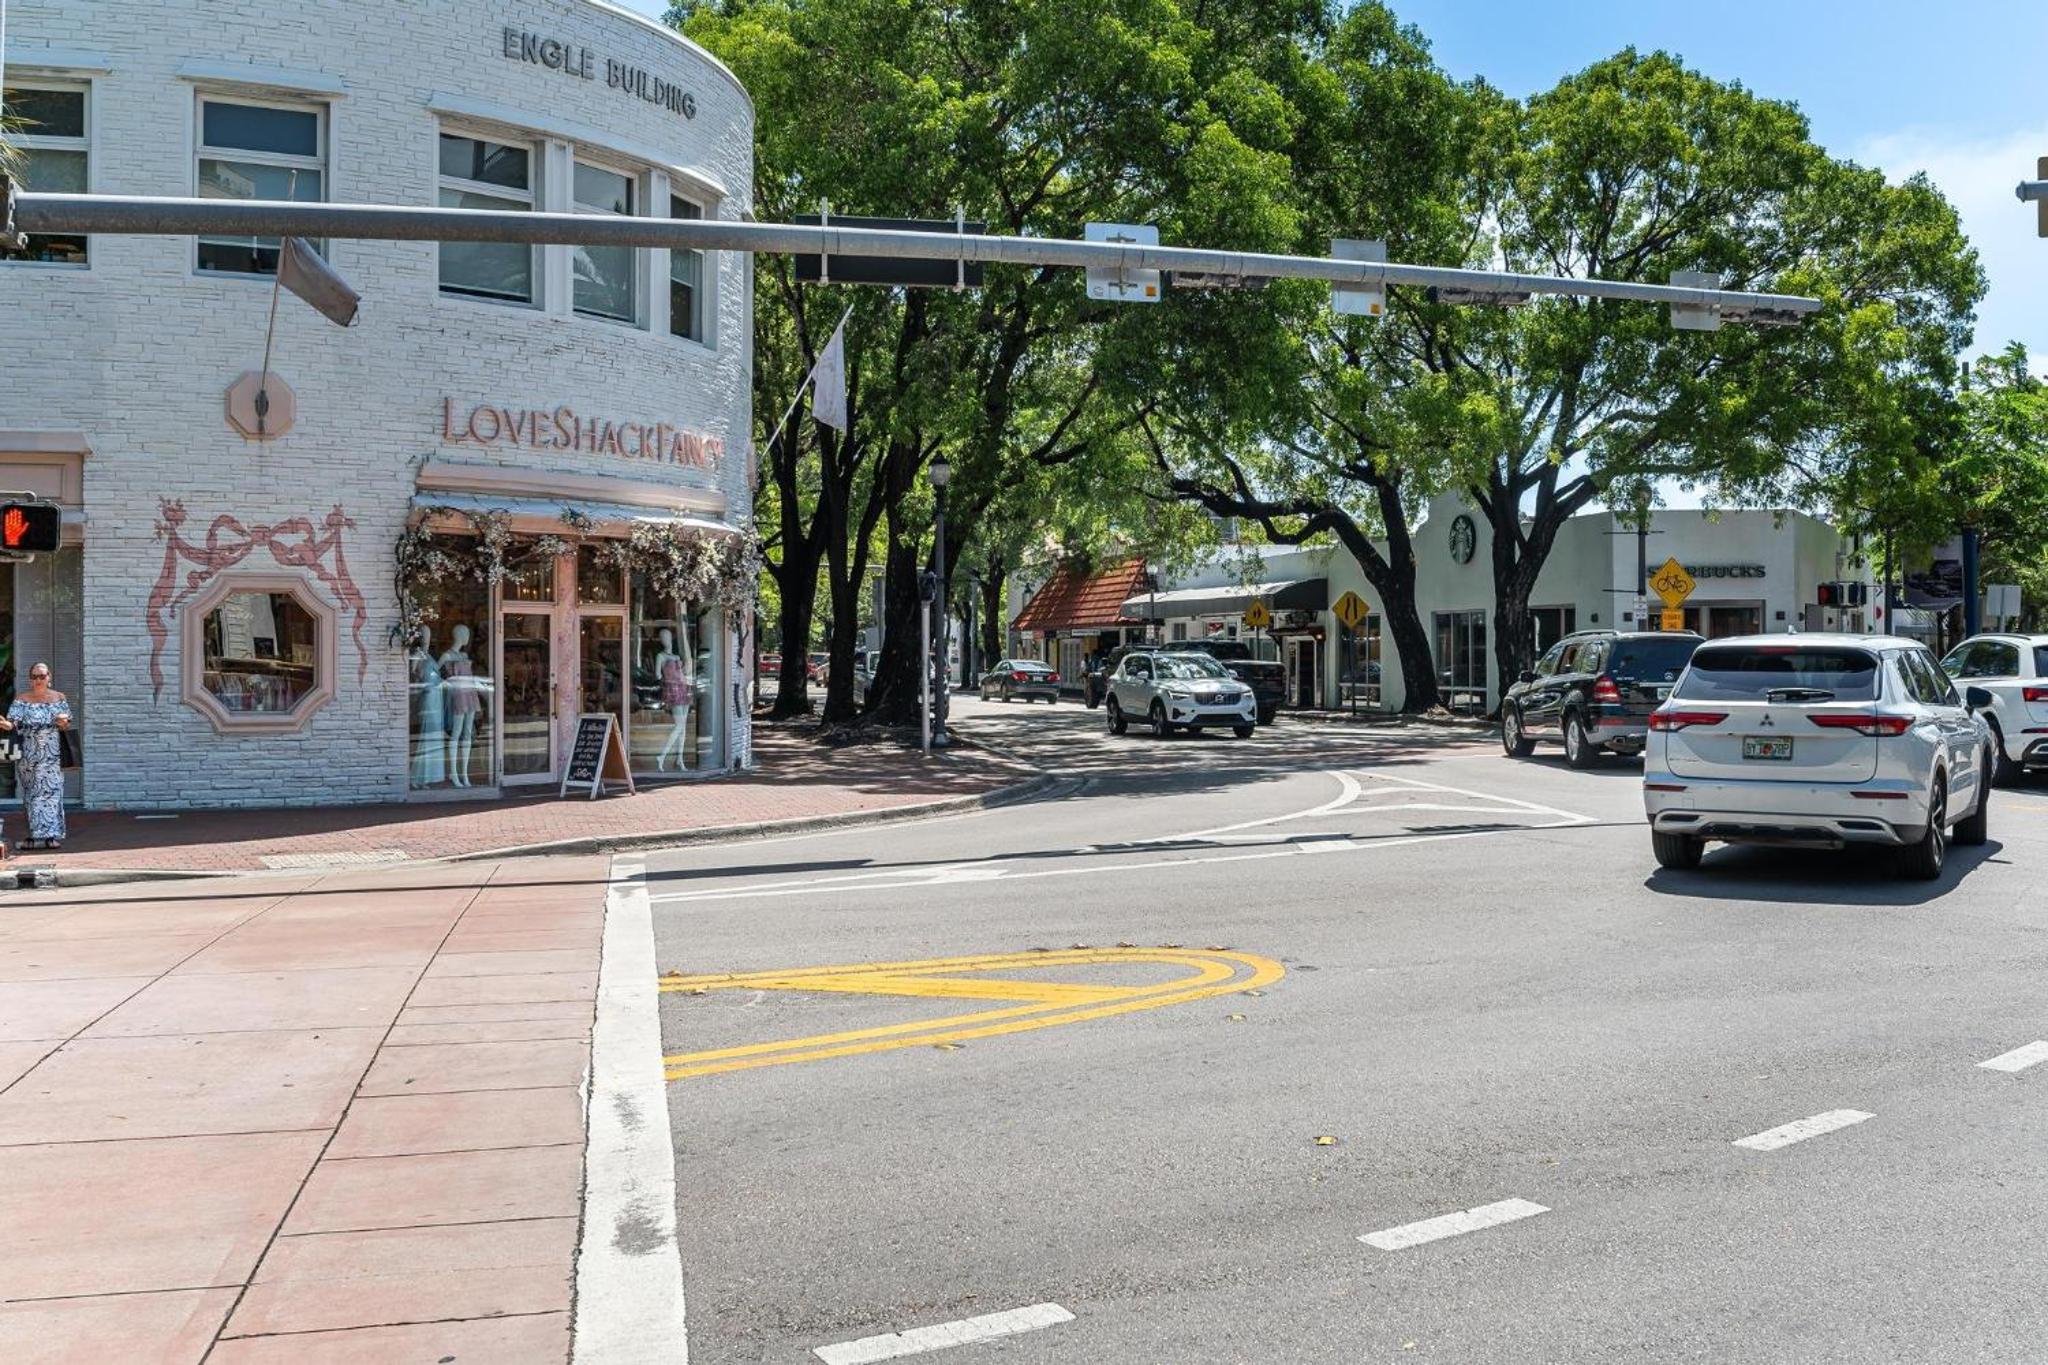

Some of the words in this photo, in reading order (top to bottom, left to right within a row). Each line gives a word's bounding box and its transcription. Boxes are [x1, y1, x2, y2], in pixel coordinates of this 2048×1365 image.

[503, 26, 595, 81] ENGLE
[607, 57, 698, 120] BUILDING
[1647, 564, 1767, 579] SRBUCKS
